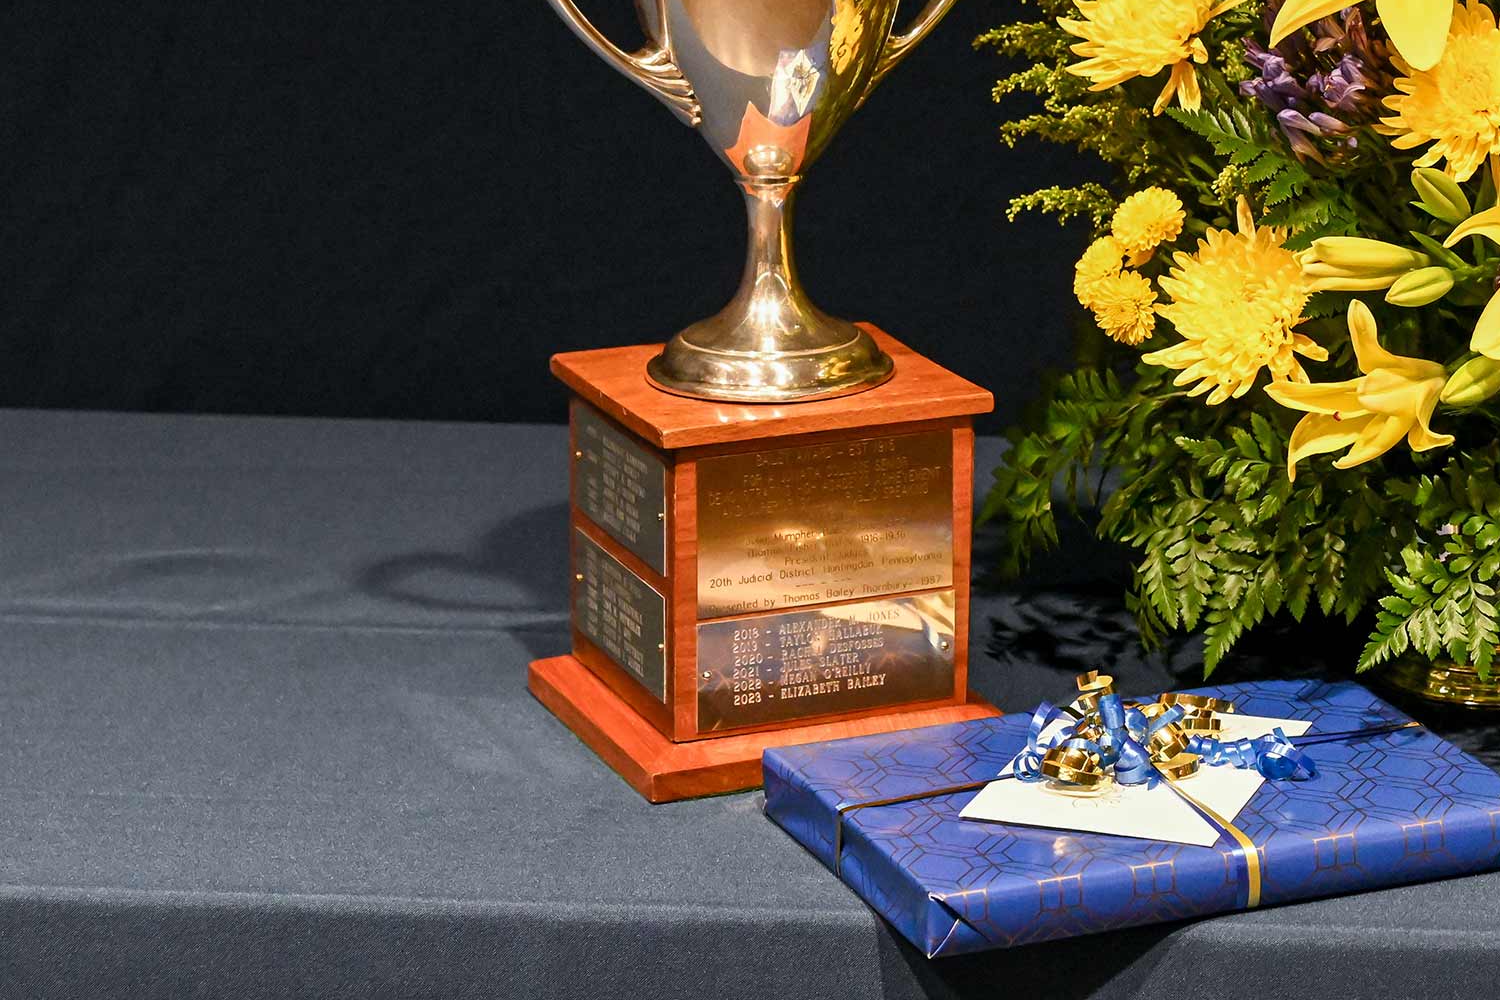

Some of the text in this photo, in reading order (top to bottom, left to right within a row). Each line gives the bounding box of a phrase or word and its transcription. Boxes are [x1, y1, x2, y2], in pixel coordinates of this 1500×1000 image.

[710, 577, 733, 590] 20th
[738, 571, 774, 586] Judicial
[779, 567, 816, 580] District
[881, 551, 943, 567] Pennsylvania
[763, 598, 776, 609] by
[783, 592, 821, 604] Thomas
[826, 587, 856, 599] Bailey
[919, 574, 943, 586] 1987
[733, 626, 761, 642] 2018
[868, 608, 901, 622] JONES
[732, 666, 760, 680] 2021
[818, 652, 860, 668] SLATER
[734, 652, 764, 667] 2020
[733, 678, 762, 693] 2022
[824, 662, 872, 680] O'REILLY
[733, 691, 762, 706] 2023
[780, 680, 841, 701] ELIZABETH
[847, 673, 887, 691] BAILEY
